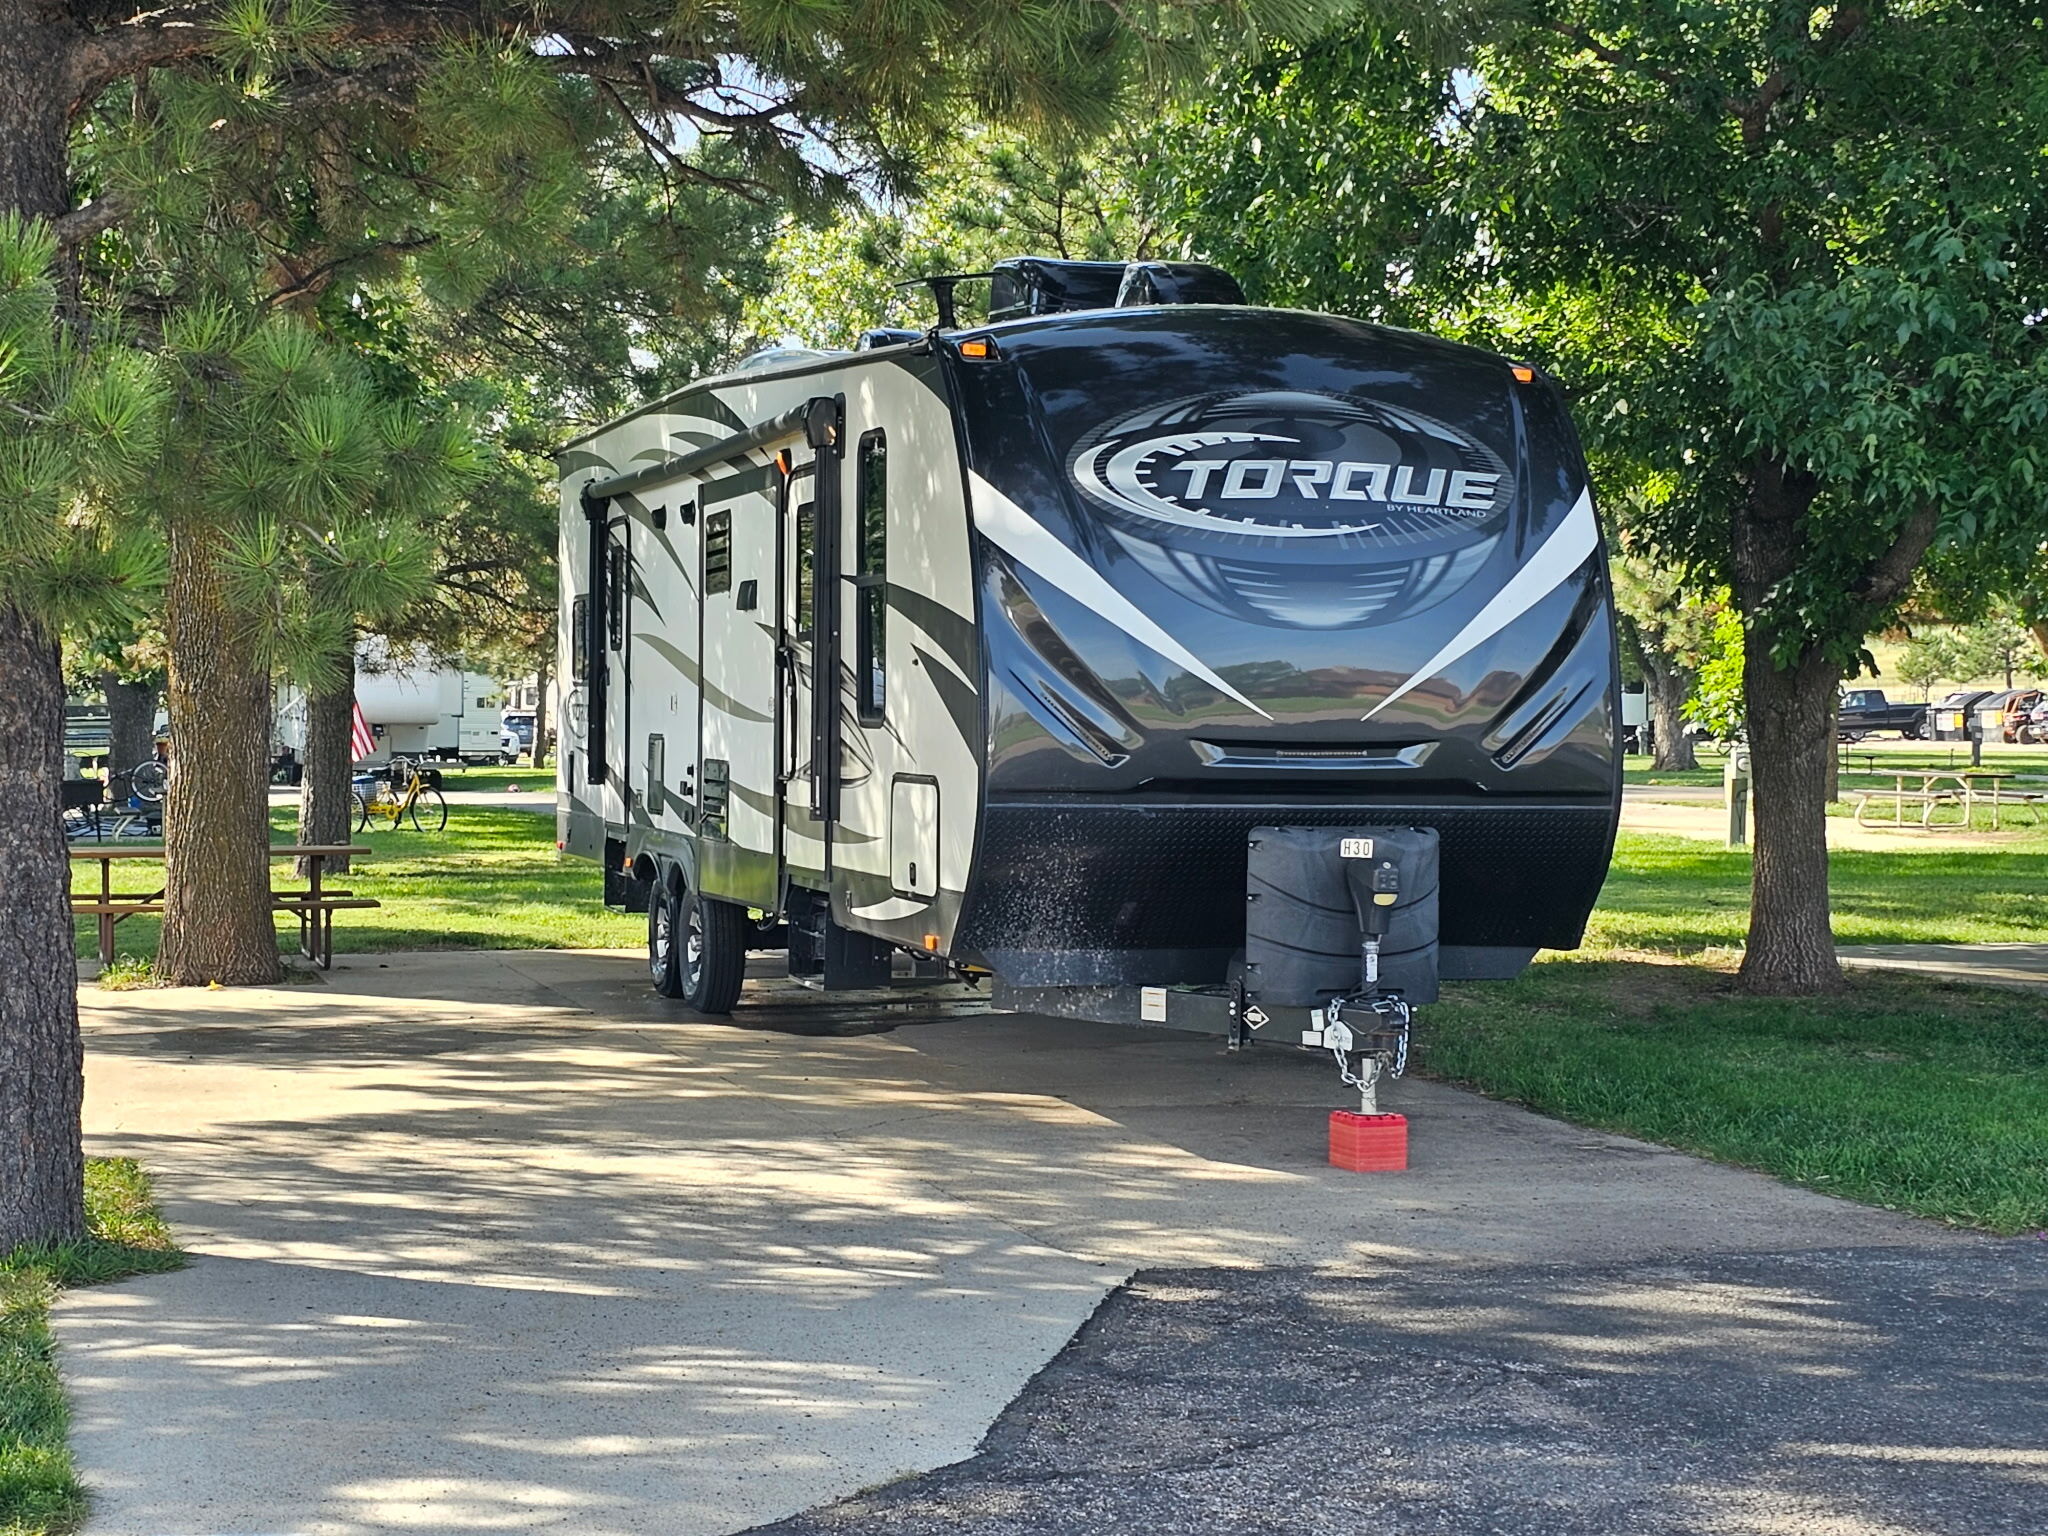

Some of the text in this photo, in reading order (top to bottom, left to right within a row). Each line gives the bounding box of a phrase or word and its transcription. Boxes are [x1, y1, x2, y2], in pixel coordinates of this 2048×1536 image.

[1171, 459, 1501, 510] TORQUE
[1386, 503, 1487, 519] BY HEARTLAND
[1343, 840, 1370, 856] H30
